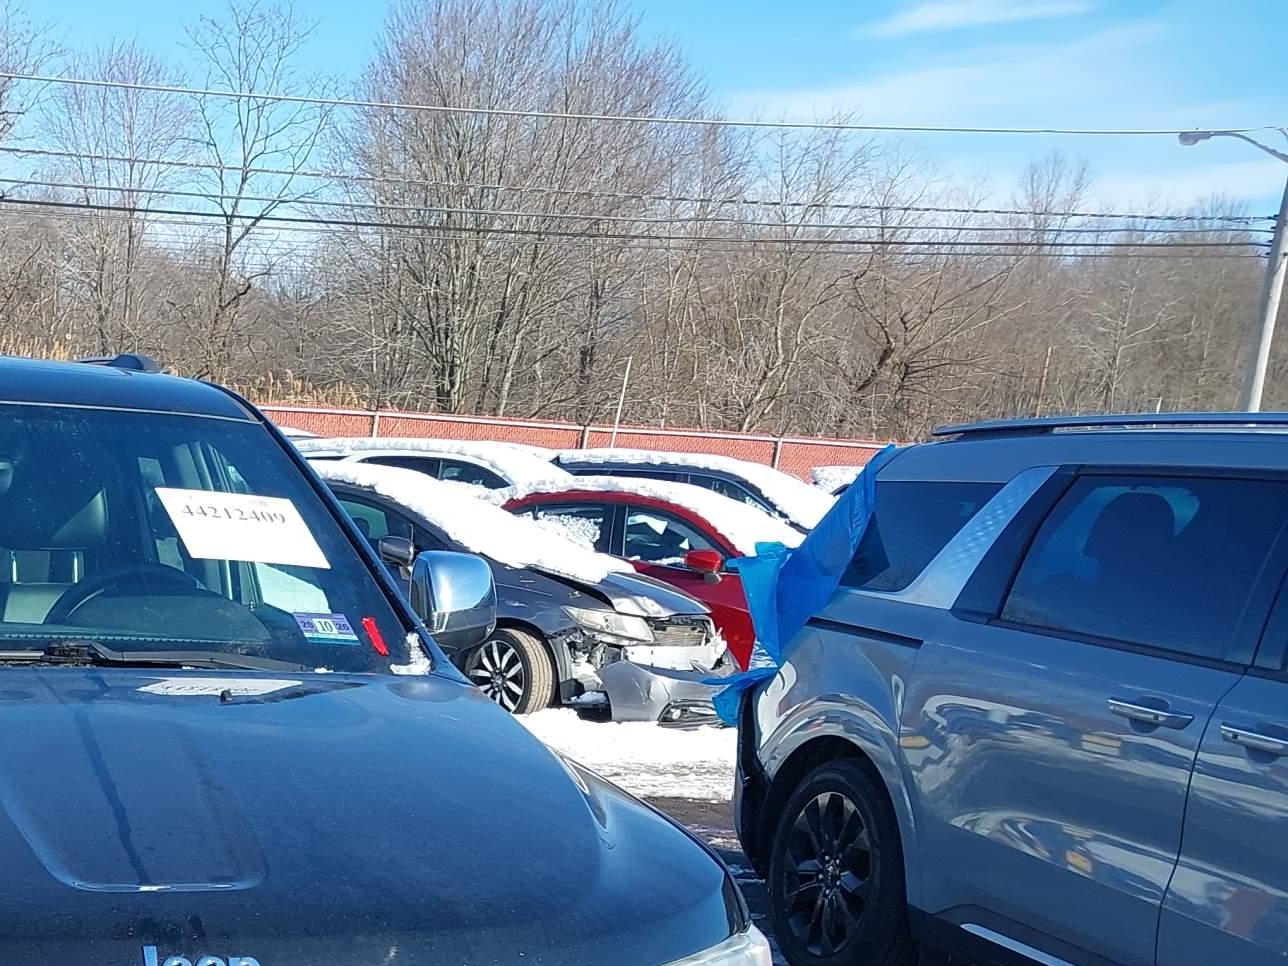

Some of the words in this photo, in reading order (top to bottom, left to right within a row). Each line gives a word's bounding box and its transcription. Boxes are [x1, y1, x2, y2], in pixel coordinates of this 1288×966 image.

[182, 504, 286, 525] 44212409
[300, 620, 315, 630] 20
[317, 620, 334, 633] 10
[335, 622, 350, 631] 26
